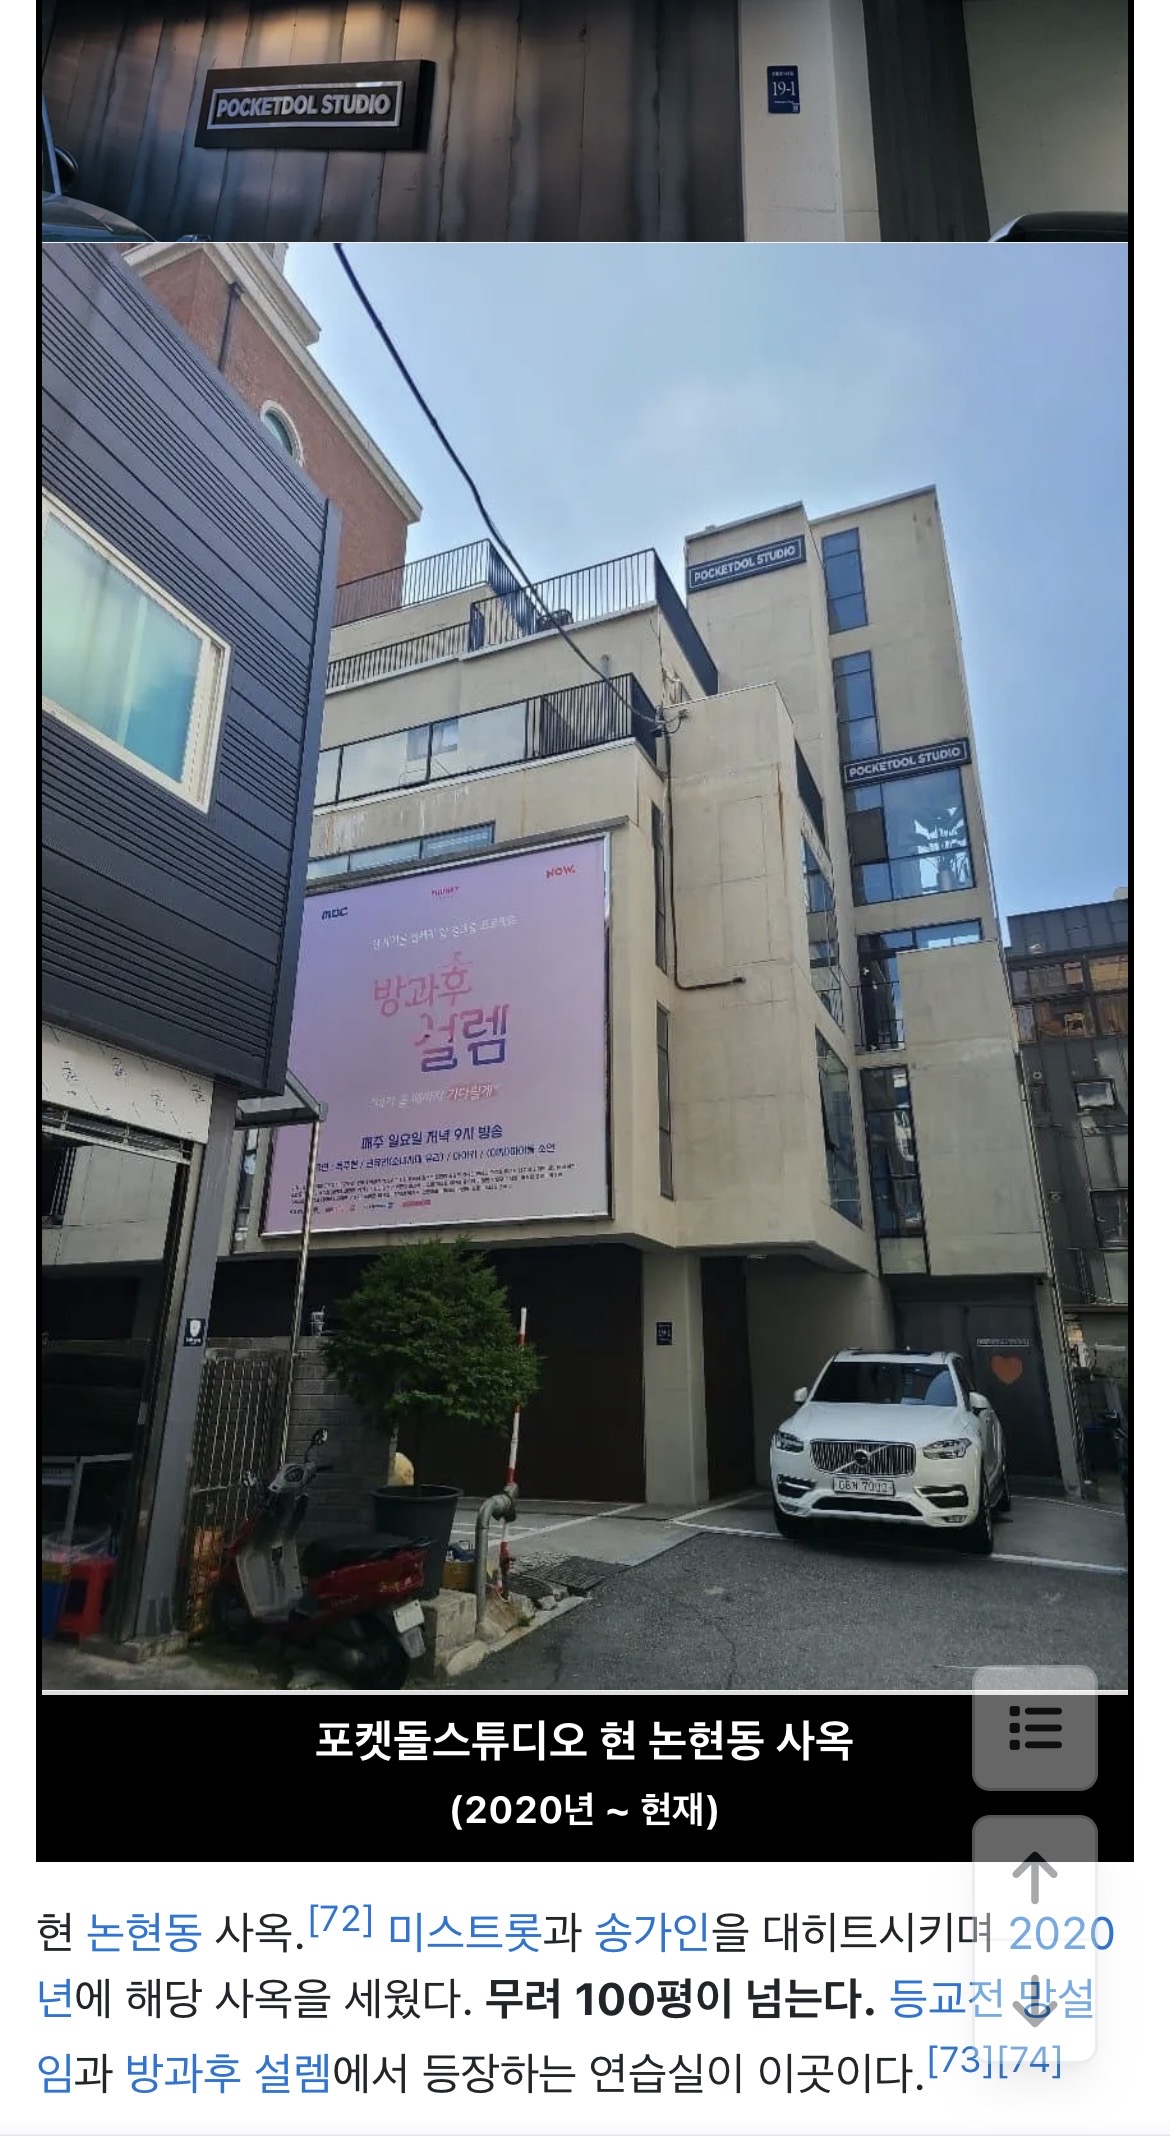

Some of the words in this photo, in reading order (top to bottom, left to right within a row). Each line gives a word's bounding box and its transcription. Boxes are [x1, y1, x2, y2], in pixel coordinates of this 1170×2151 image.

[772, 81, 796, 96] 19-1
[216, 95, 319, 118] POCKETDOL
[320, 94, 392, 116] STUDIO
[694, 557, 756, 582] POCKETDOL
[757, 545, 797, 566] STUDIO
[848, 756, 918, 778] POCKETDOL
[917, 746, 961, 764] STUDIO
[373, 953, 473, 1018] 방과후
[413, 1003, 510, 1073] 설렘
[361, 1135, 385, 1151] 매주
[387, 1131, 423, 1149] 일요일
[426, 1129, 450, 1144] 저녁
[454, 1126, 474, 1141] 9시
[478, 1124, 503, 1140] 방송
